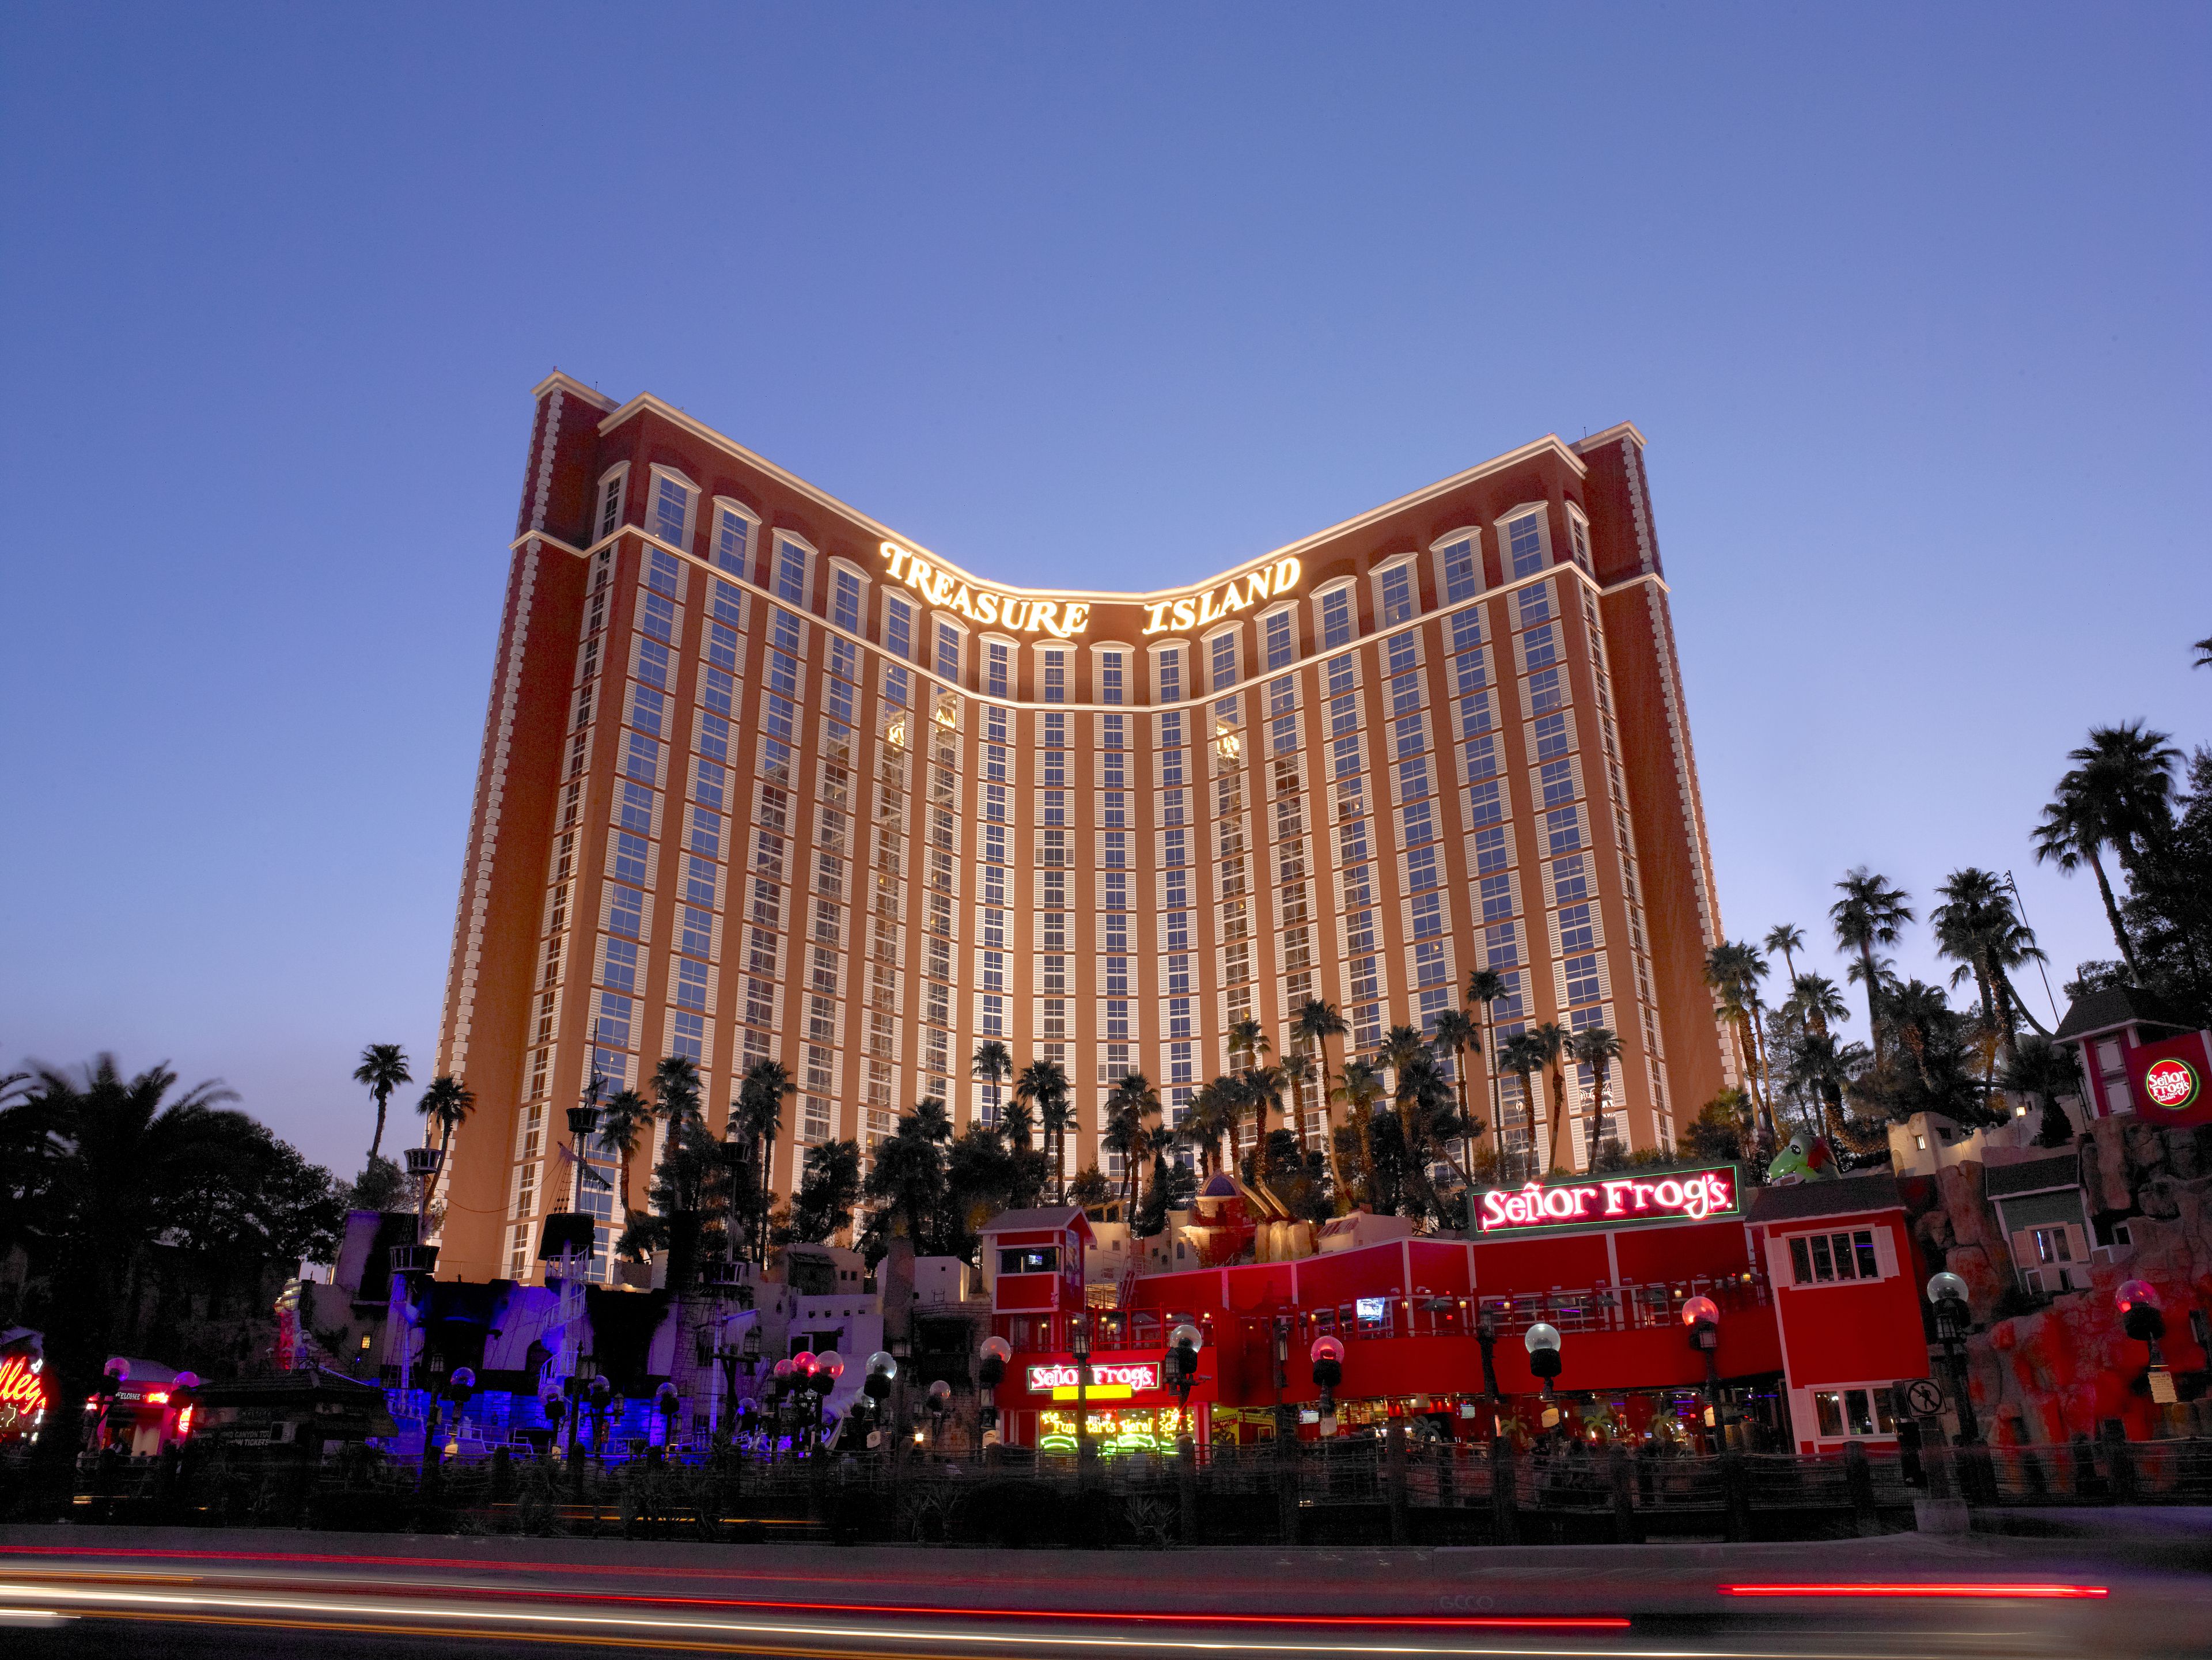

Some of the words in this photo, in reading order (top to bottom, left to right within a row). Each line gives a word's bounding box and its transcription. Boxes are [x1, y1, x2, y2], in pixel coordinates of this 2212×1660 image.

[879, 541, 1090, 637] TREASURE
[1142, 558, 1301, 635] ISLAND
[2149, 1071, 2187, 1088] Señor
[2152, 1081, 2190, 1097] Frog's
[1483, 1182, 1596, 1233] Señor
[1031, 1364, 1078, 1389] Seño
[115, 1392, 141, 1400] WELCOME
[1085, 1420, 1116, 1434] tarts
[1120, 1418, 1154, 1434] Here!
